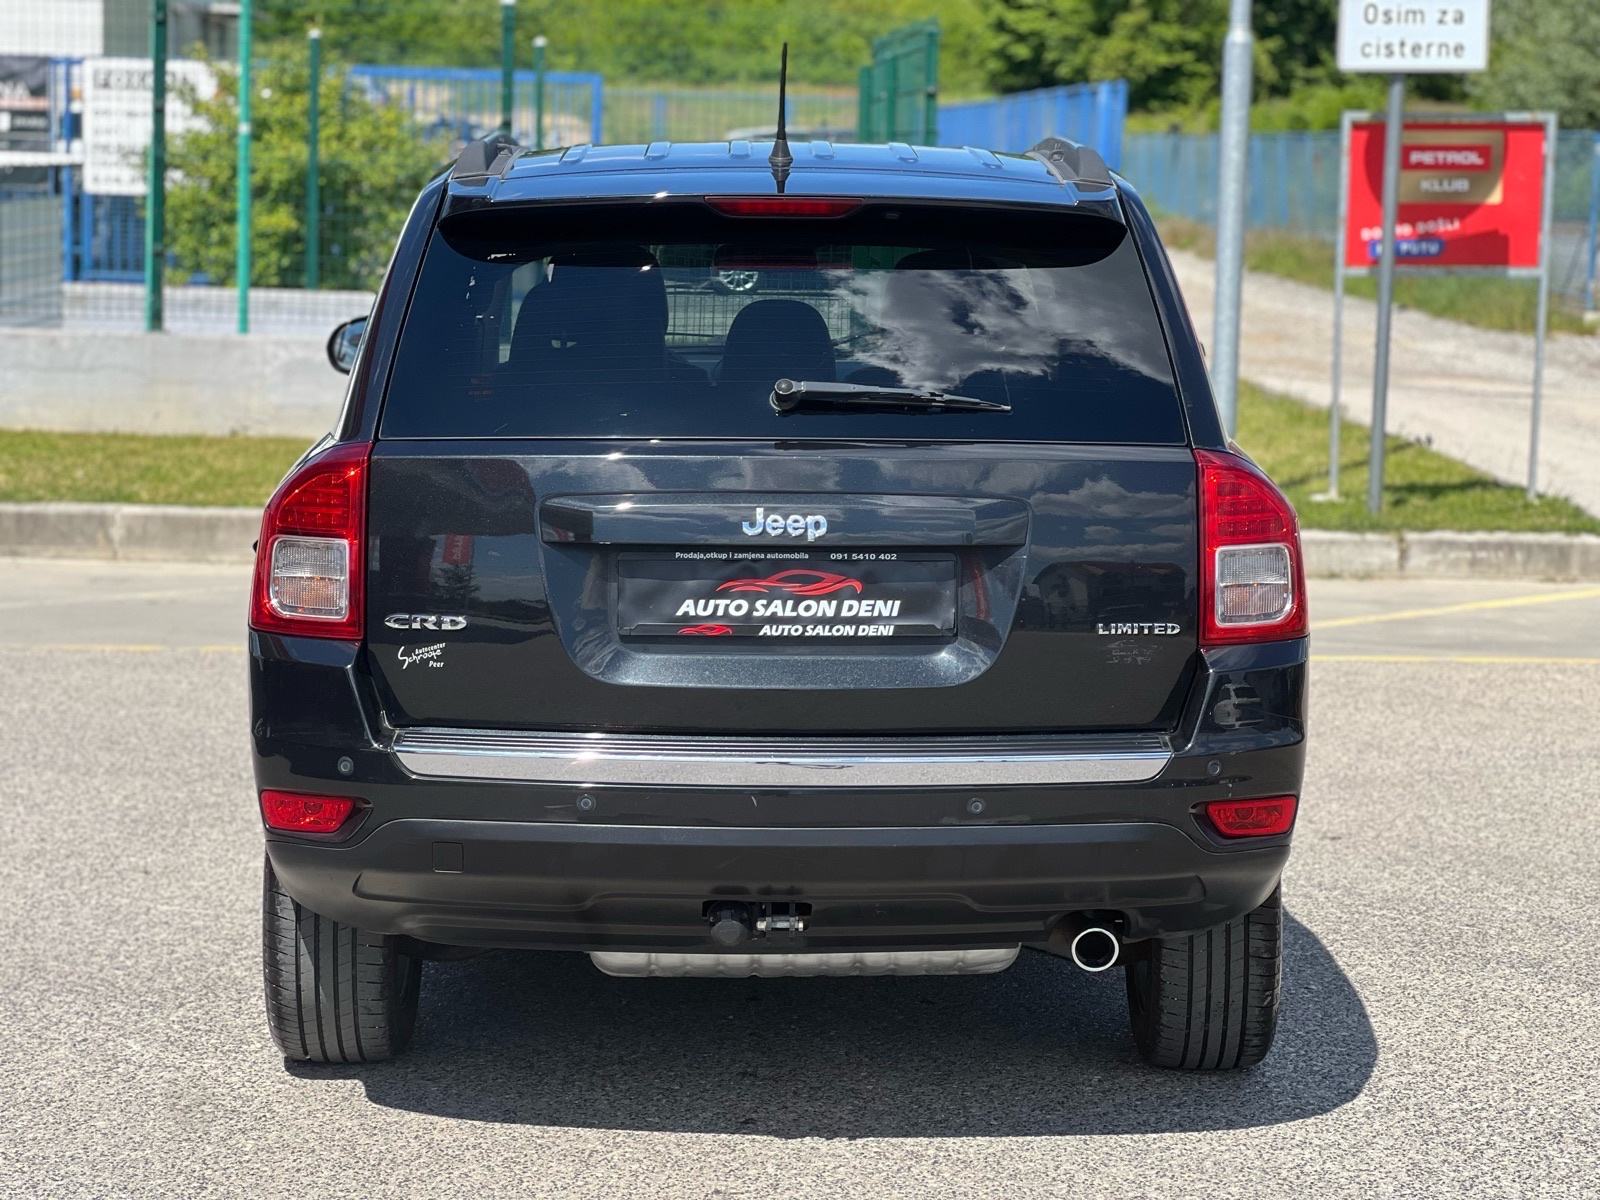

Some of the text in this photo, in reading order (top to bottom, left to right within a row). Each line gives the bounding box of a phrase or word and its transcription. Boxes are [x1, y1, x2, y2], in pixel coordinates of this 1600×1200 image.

[1364, 4, 1464, 25] Osim za
[1361, 38, 1465, 58] cisterne
[1409, 151, 1484, 165] PETROL
[1420, 178, 1470, 192] KLUB
[742, 507, 827, 542] Jeep
[675, 552, 728, 560] Prodaja,otkup
[734, 552, 765, 560] zamjena
[766, 552, 809, 560] automobila
[676, 599, 901, 617] AUTO SALON DENI
[384, 614, 467, 630] CRD
[1098, 623, 1181, 635] LIMITED
[759, 625, 895, 636] AUTO SALON DENI
[415, 642, 447, 656] Autocenter
[429, 660, 445, 668] Peer
